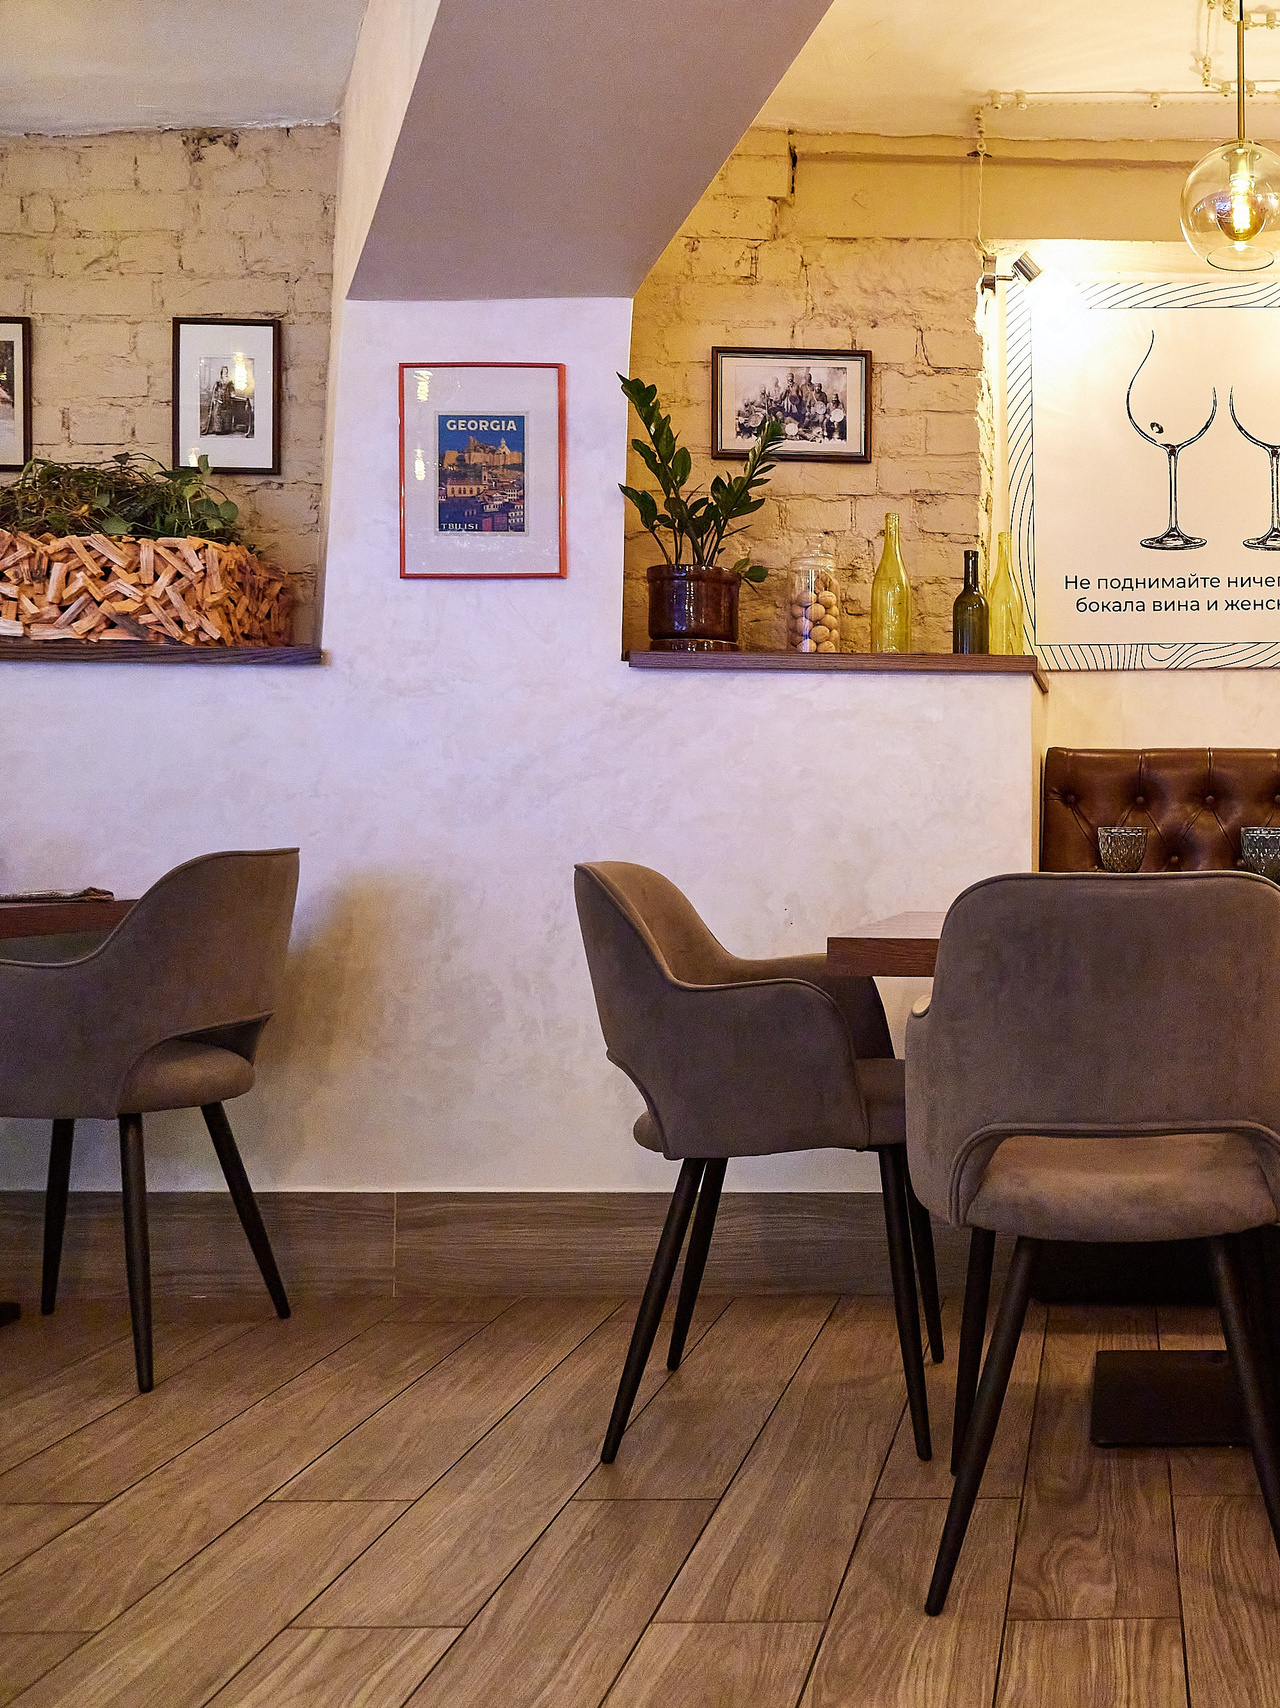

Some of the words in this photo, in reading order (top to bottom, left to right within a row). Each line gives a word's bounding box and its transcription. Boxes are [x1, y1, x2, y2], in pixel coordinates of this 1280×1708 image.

[446, 419, 517, 431] GEORGIA
[1064, 575, 1091, 590] Не
[1097, 573, 1221, 592] поднимайте
[1075, 596, 1146, 613] бокала
[1152, 600, 1200, 612] вина
[1207, 599, 1218, 612] и
